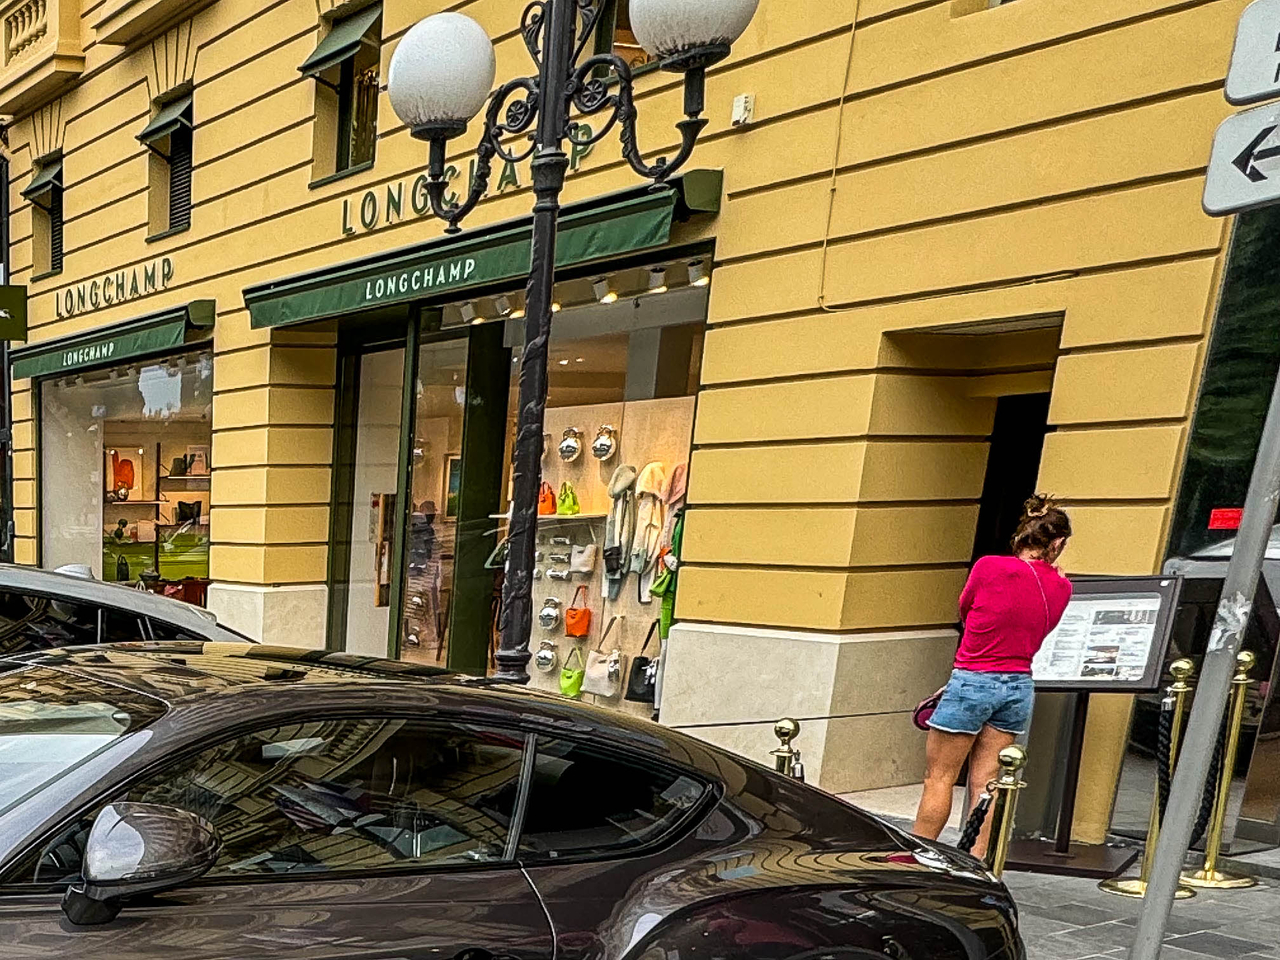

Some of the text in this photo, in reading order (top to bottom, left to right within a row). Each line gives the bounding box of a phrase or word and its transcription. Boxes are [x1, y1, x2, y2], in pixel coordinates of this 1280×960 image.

[342, 123, 594, 236] LONGCAP
[55, 257, 173, 319] LONGCHAMP
[365, 258, 476, 300] LONGCHAMP
[62, 342, 115, 367] LONGCHAMP
